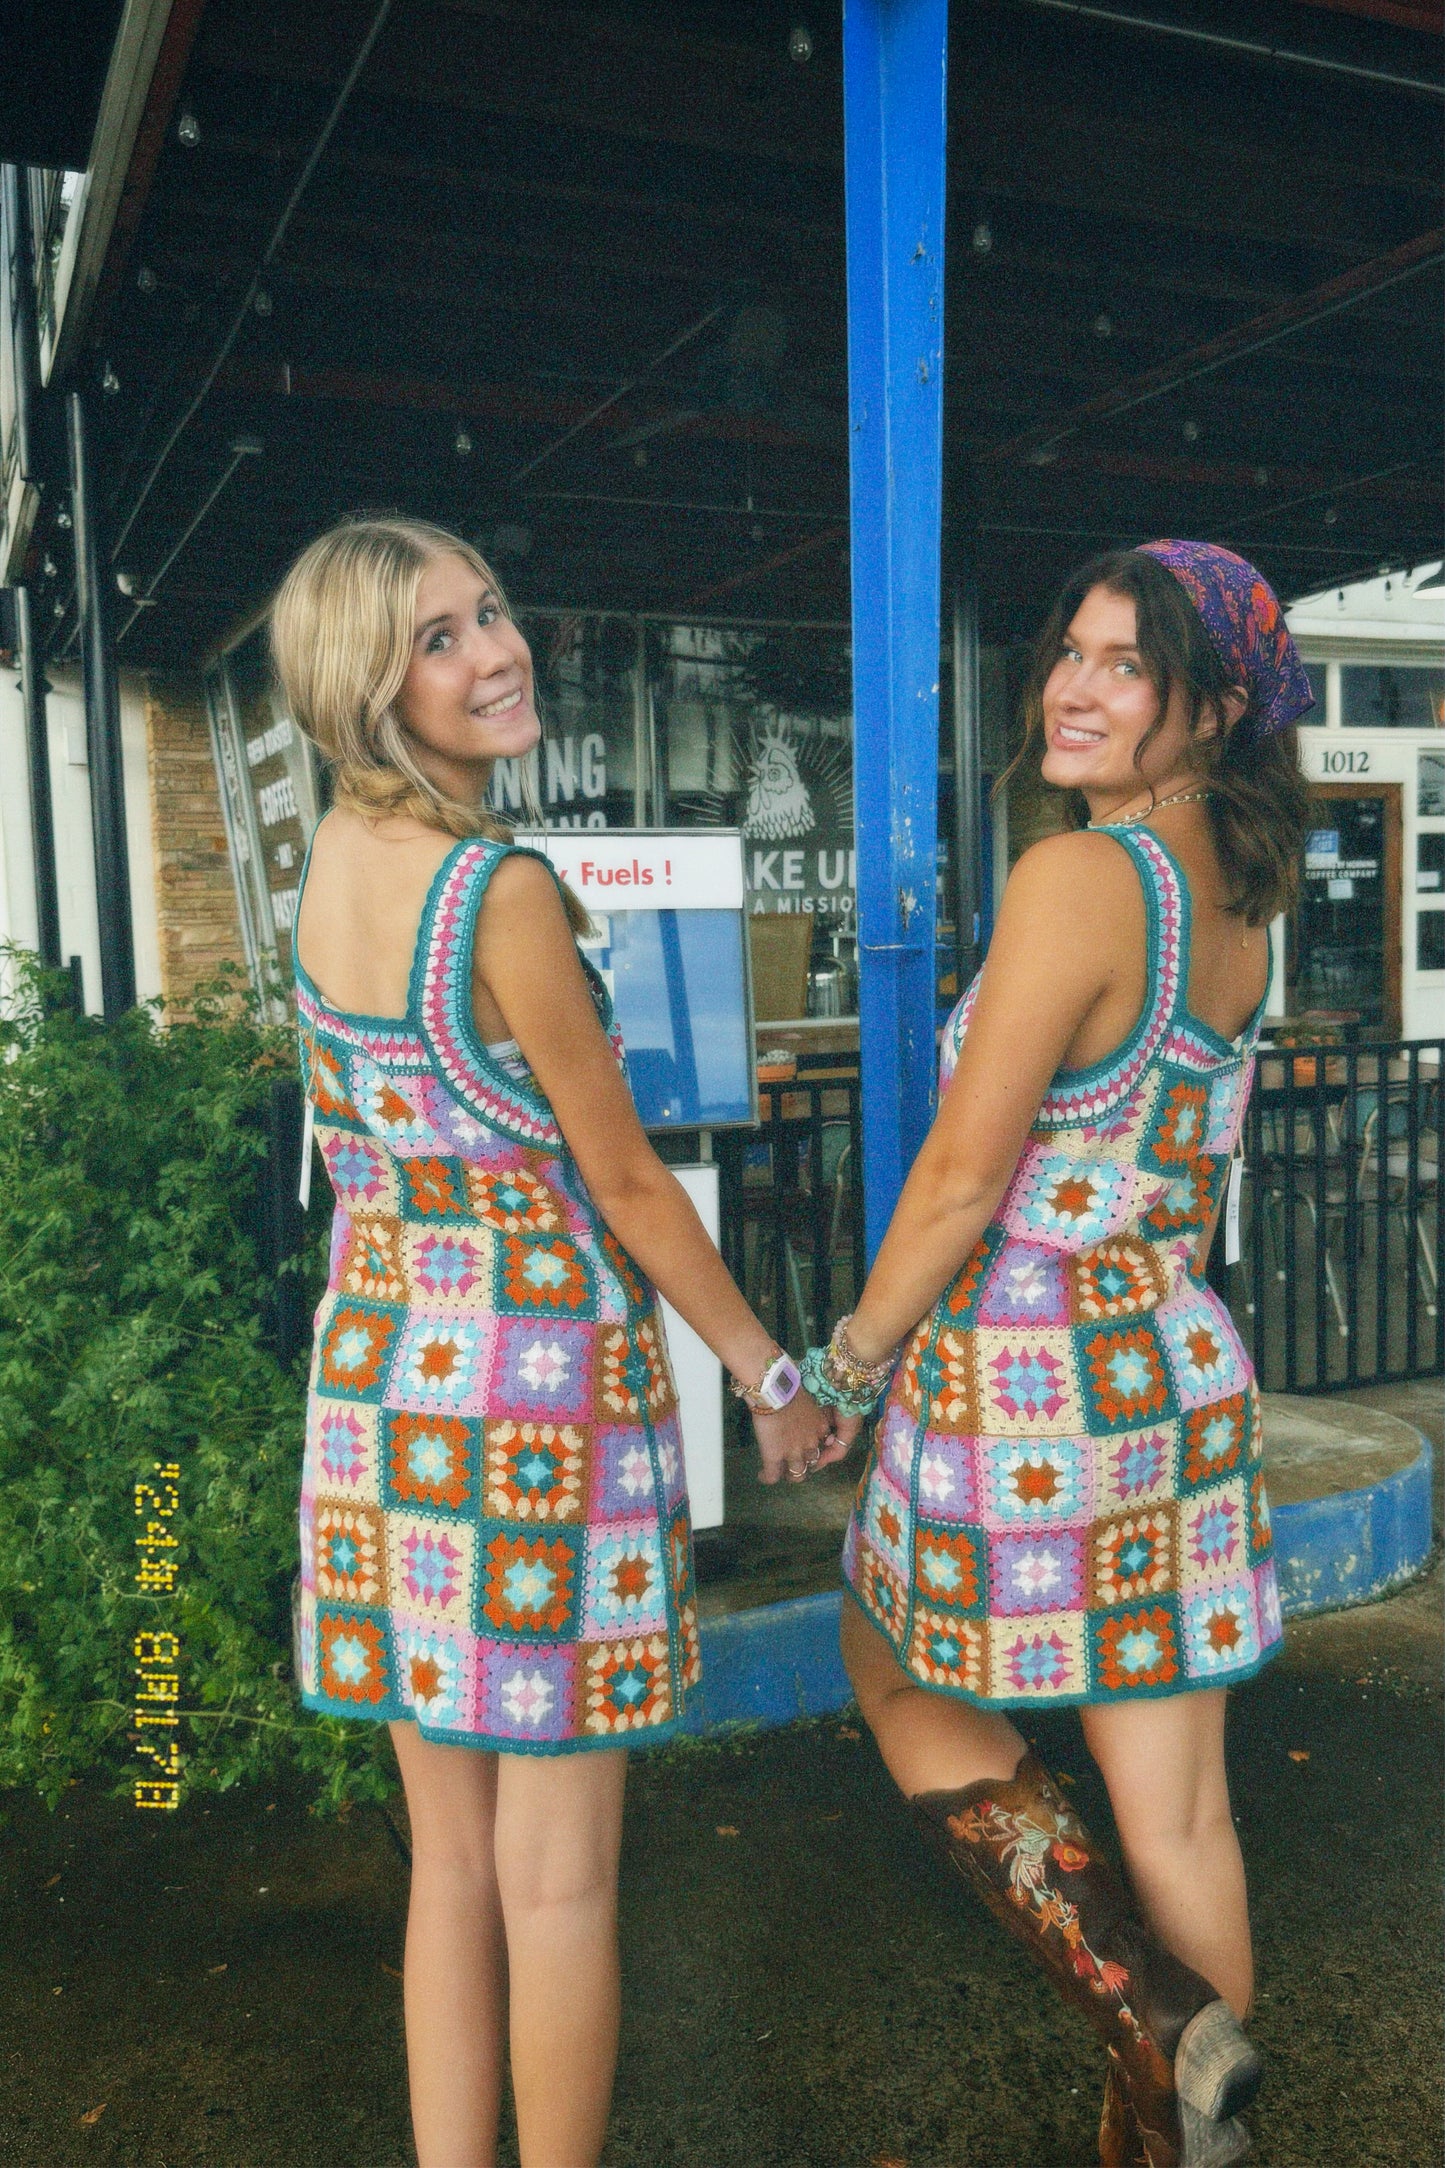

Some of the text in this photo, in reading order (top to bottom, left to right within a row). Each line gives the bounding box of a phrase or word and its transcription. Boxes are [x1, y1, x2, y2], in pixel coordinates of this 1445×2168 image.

[494, 733, 606, 811] NING
[1321, 751, 1370, 773] 1012
[581, 859, 654, 886] Fuels
[745, 850, 805, 890] KE
[1305, 870, 1336, 880] COFFEE
[753, 896, 853, 915] A MISSIO
